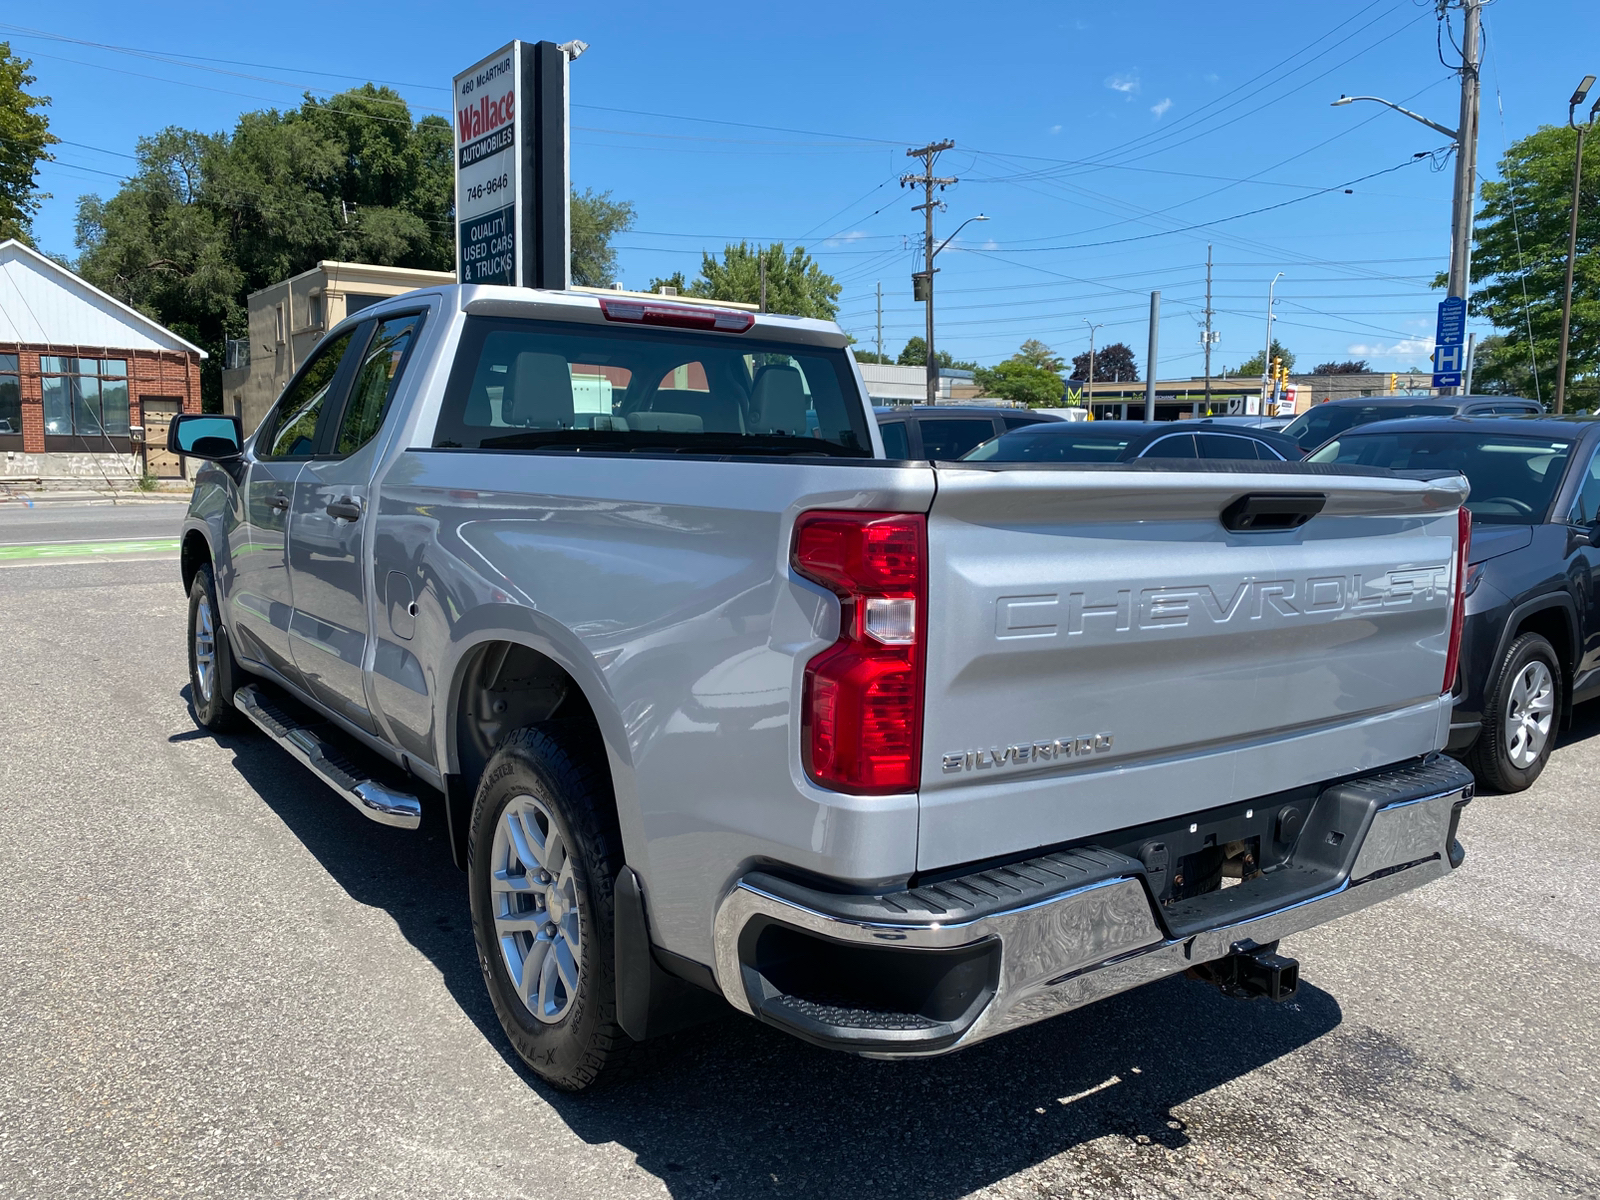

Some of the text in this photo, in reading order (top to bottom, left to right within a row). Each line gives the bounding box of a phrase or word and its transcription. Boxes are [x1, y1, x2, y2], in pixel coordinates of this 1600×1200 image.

[462, 58, 511, 96] 460 McARTHUR
[458, 90, 514, 144] Wallace
[462, 127, 512, 164] AUTOMOBILES
[467, 173, 508, 203] 746-9646
[470, 217, 506, 242] QUALITY
[463, 233, 513, 262] USED CARS
[464, 253, 513, 281] & TRUCKS
[1437, 347, 1459, 371] H
[995, 566, 1447, 640] CHEVROLET
[942, 731, 1115, 773] SILVERADO
